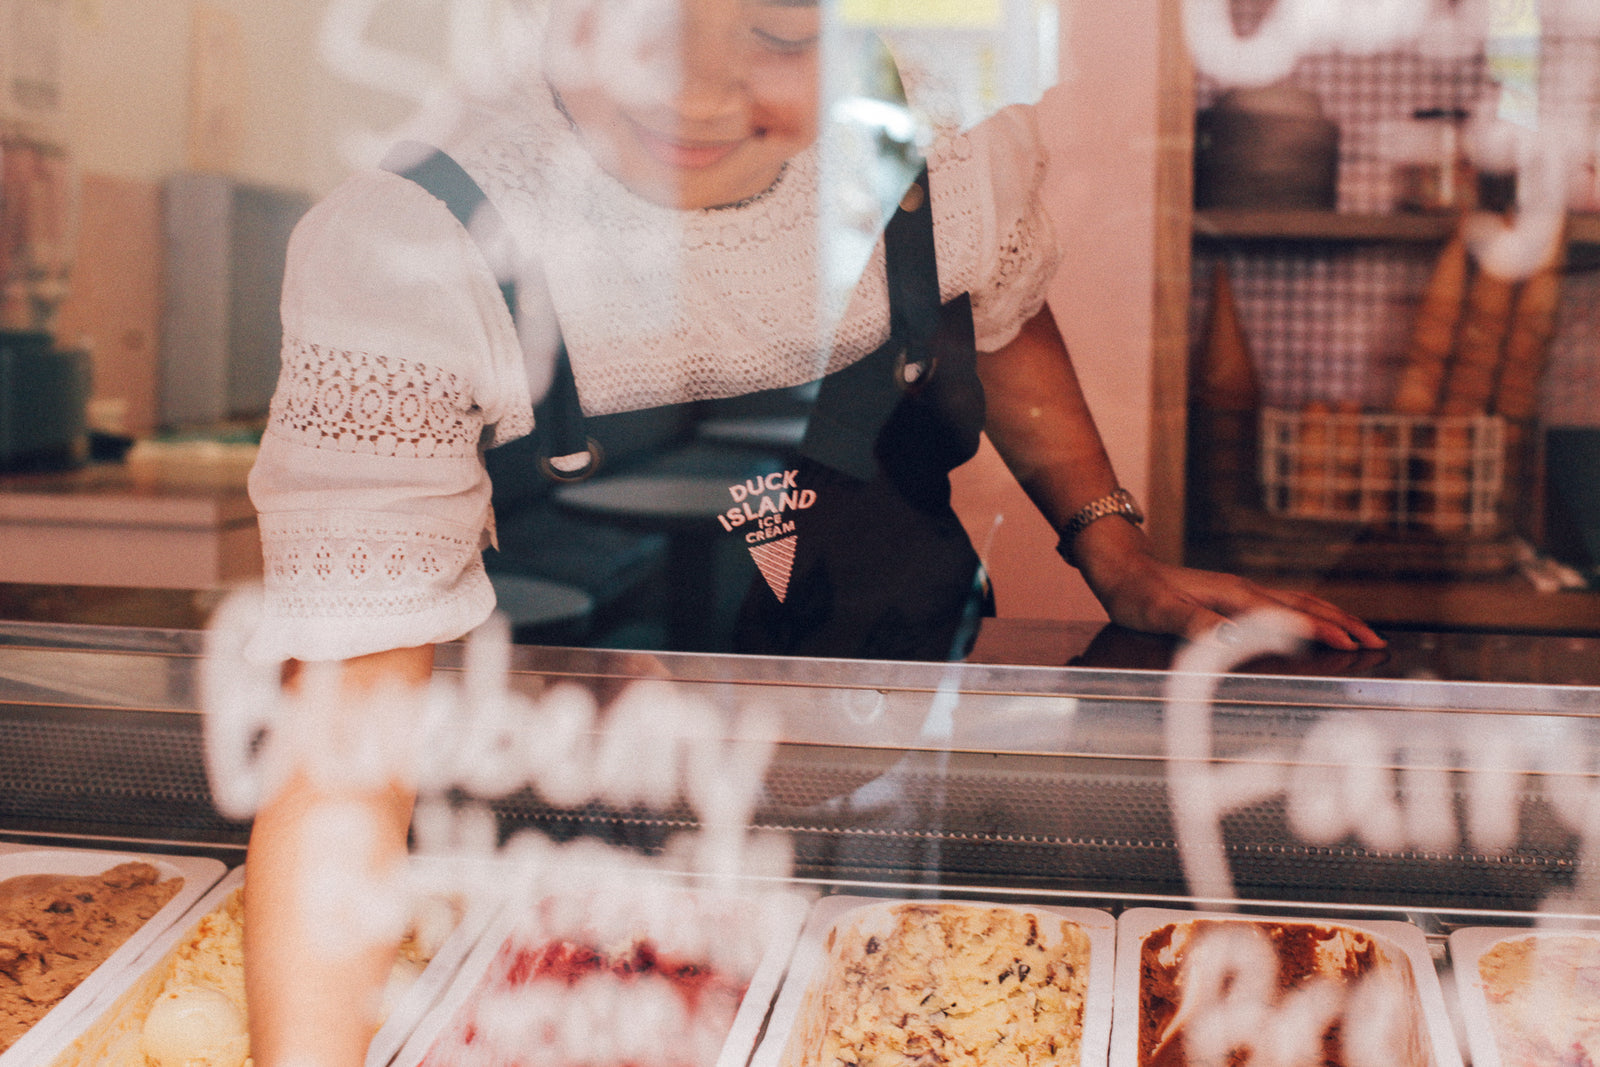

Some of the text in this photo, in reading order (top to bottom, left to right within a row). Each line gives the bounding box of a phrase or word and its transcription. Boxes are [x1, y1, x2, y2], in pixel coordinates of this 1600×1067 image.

[729, 469, 799, 503] DUCK
[717, 489, 817, 532] ISLAND
[758, 513, 783, 529] ICE
[745, 520, 796, 543] CREAM
